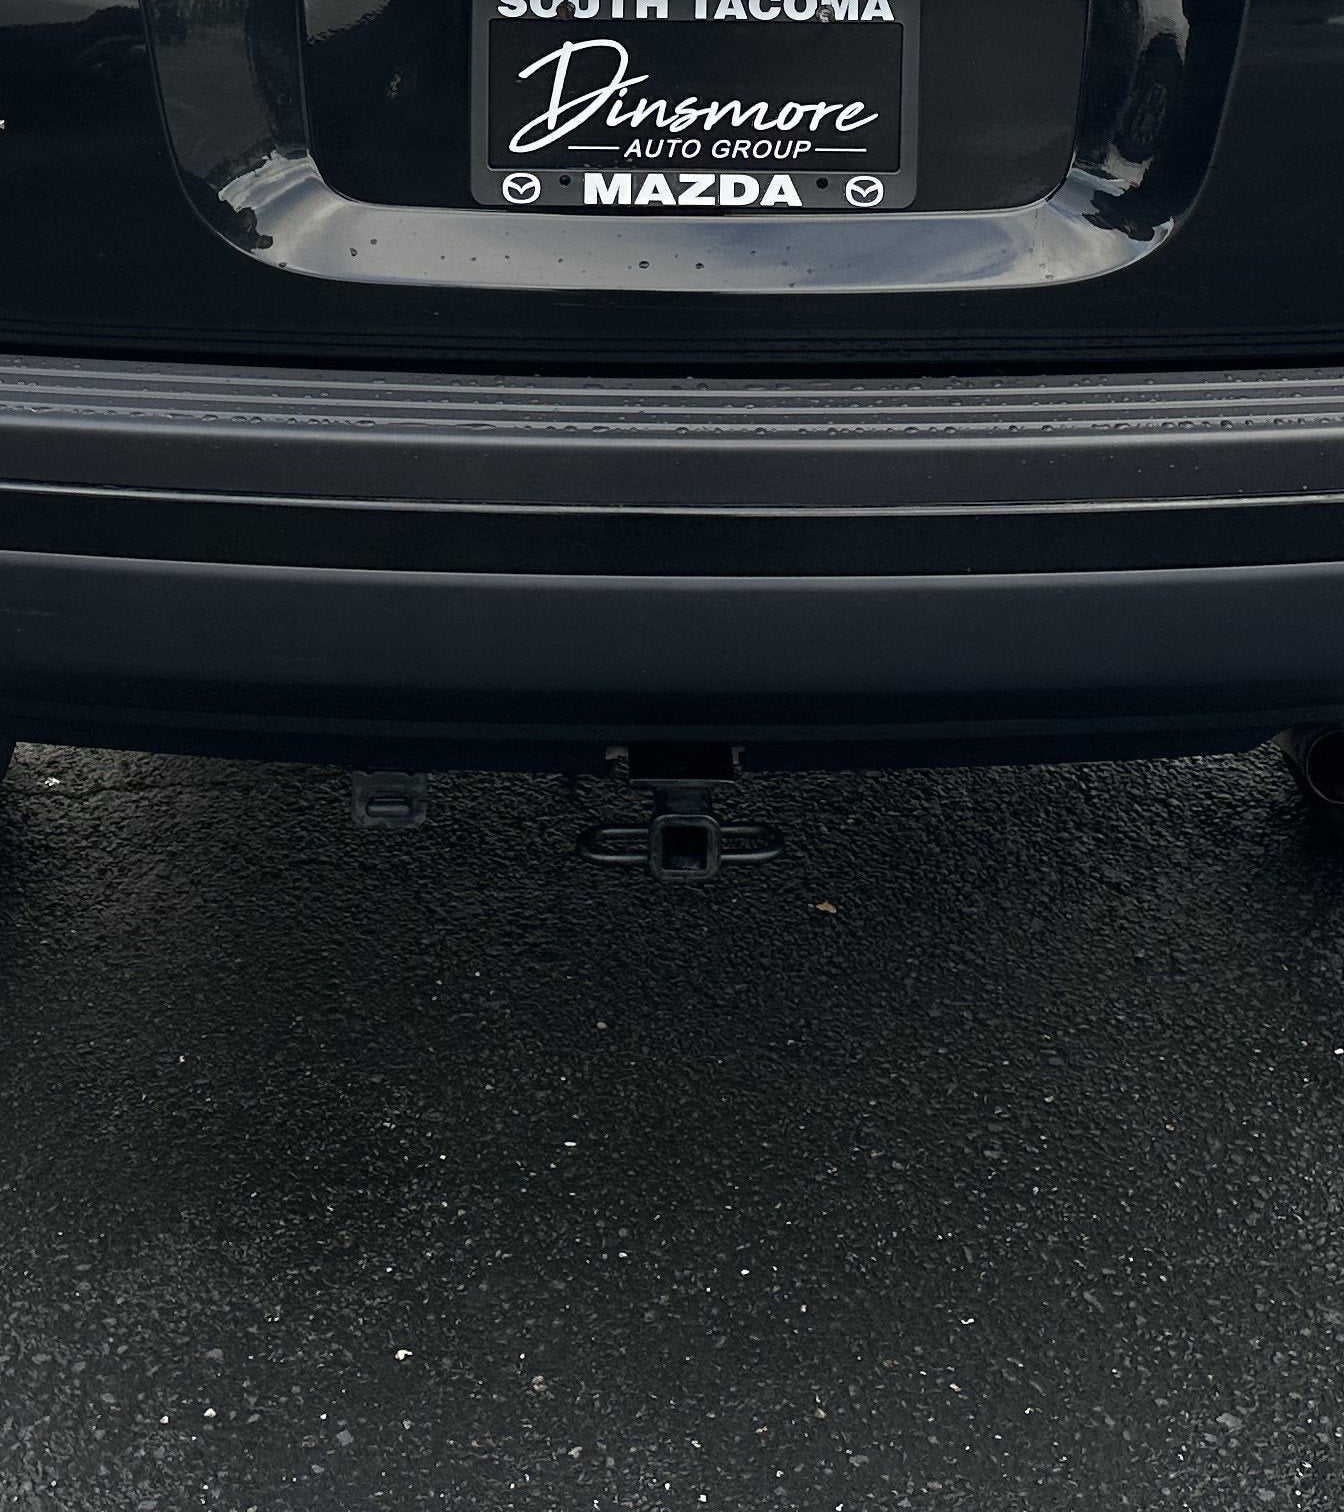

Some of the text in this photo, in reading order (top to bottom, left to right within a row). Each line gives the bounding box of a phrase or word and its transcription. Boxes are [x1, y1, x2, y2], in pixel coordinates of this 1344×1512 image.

[509, 39, 879, 153] Dinsmore
[624, 139, 812, 160] AUTO GROUP
[583, 173, 803, 207] MAZDA
